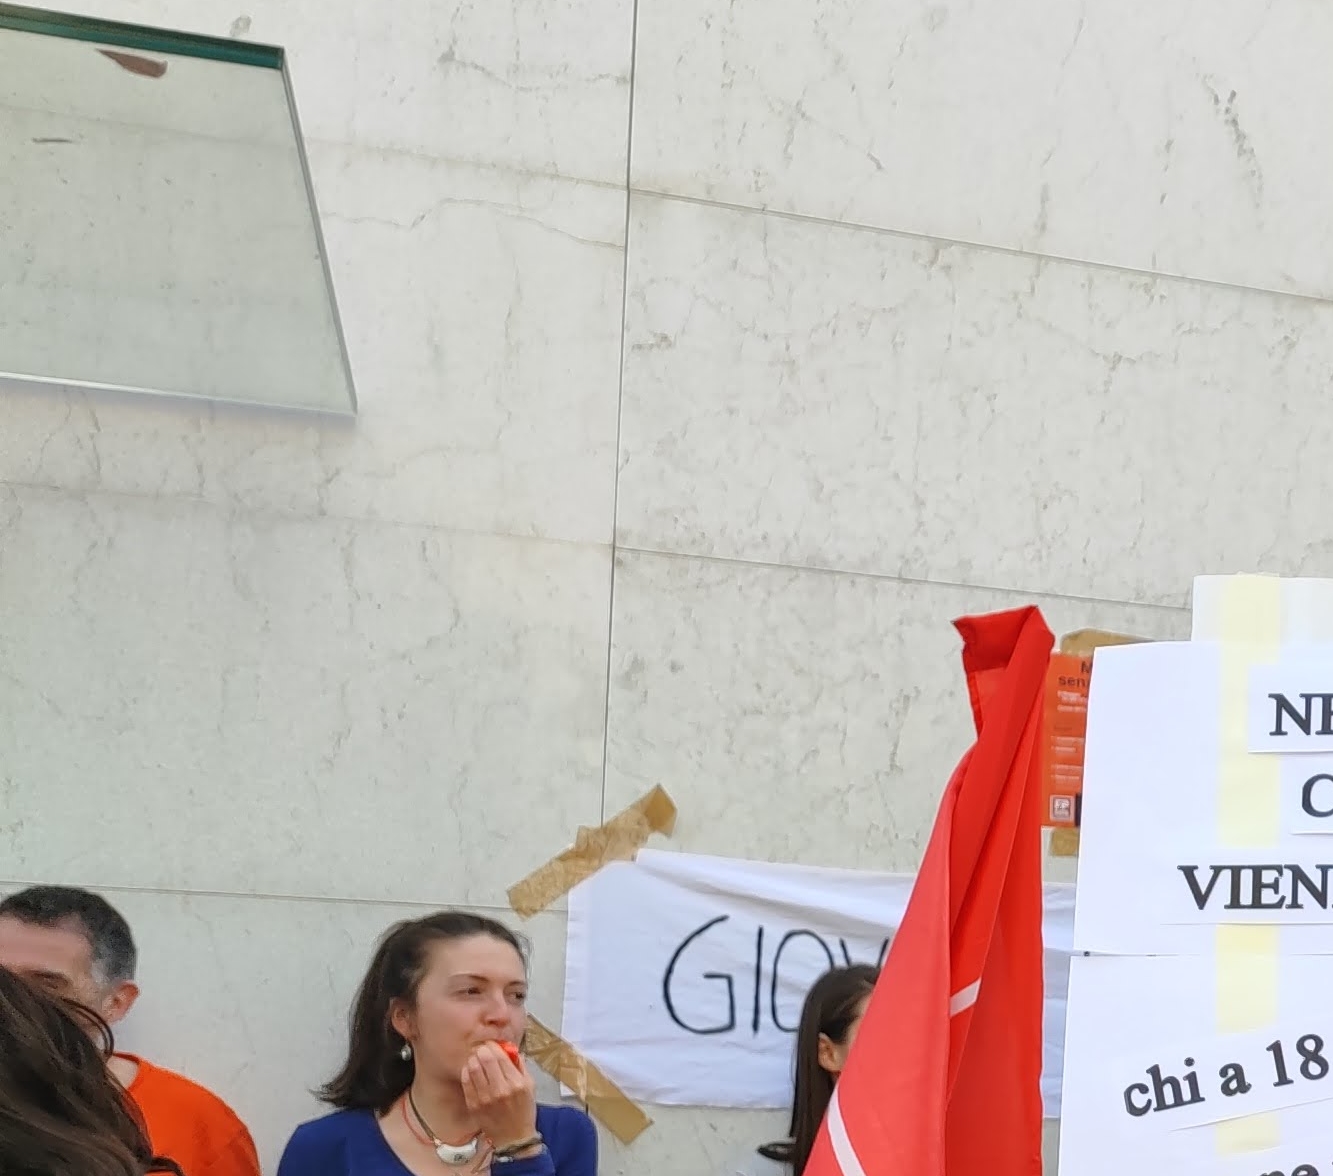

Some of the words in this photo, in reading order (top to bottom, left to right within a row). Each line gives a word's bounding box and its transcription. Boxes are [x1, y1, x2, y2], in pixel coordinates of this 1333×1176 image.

[1124, 1058, 1205, 1116] chi
[1219, 1064, 1251, 1096] a
[1267, 1035, 1328, 1086] 18
